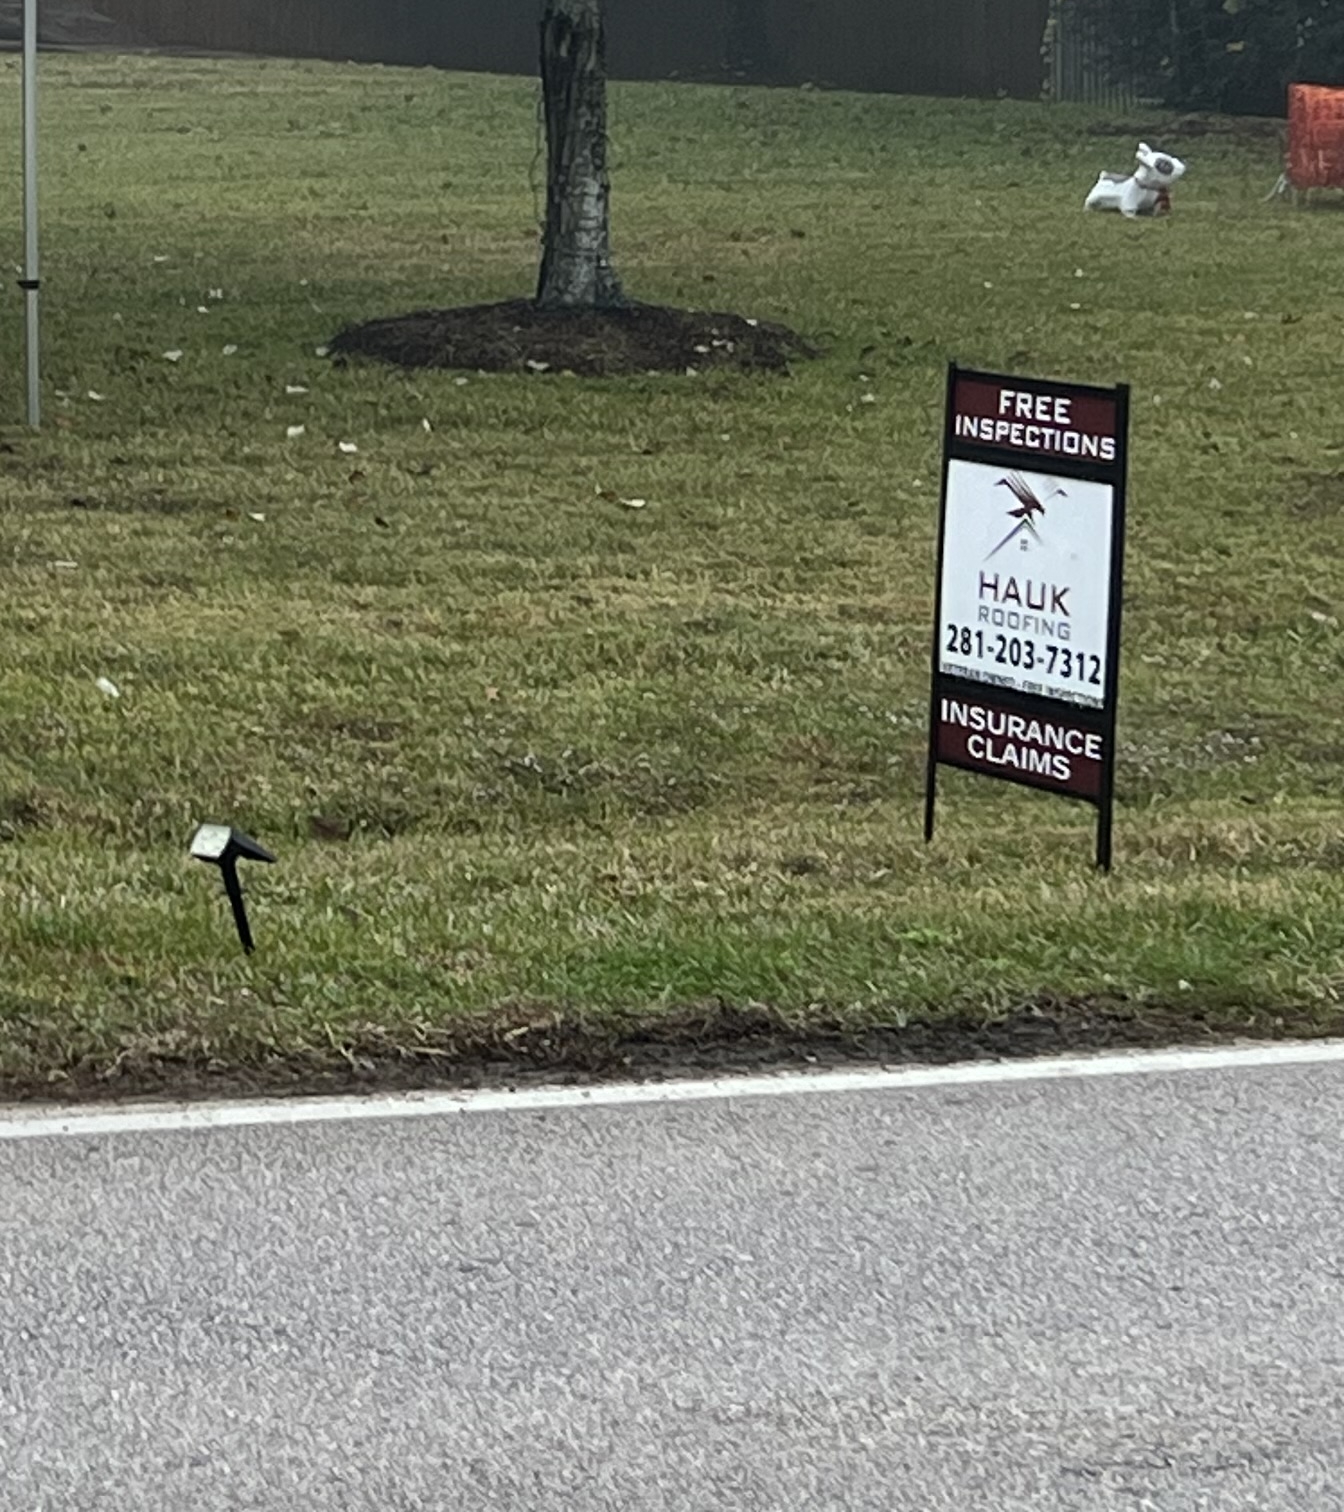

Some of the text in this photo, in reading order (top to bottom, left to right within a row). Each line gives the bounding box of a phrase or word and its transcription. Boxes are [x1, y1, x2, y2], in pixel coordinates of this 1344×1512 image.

[999, 389, 1072, 425] FREE
[955, 414, 1116, 461] INSPECTIONS
[979, 570, 1071, 617] HAUK
[978, 605, 1071, 641] ROOFING
[946, 624, 1101, 685] 281-203-7312
[941, 698, 1103, 760] INSURANCE
[967, 734, 1072, 780] CLAIMS
